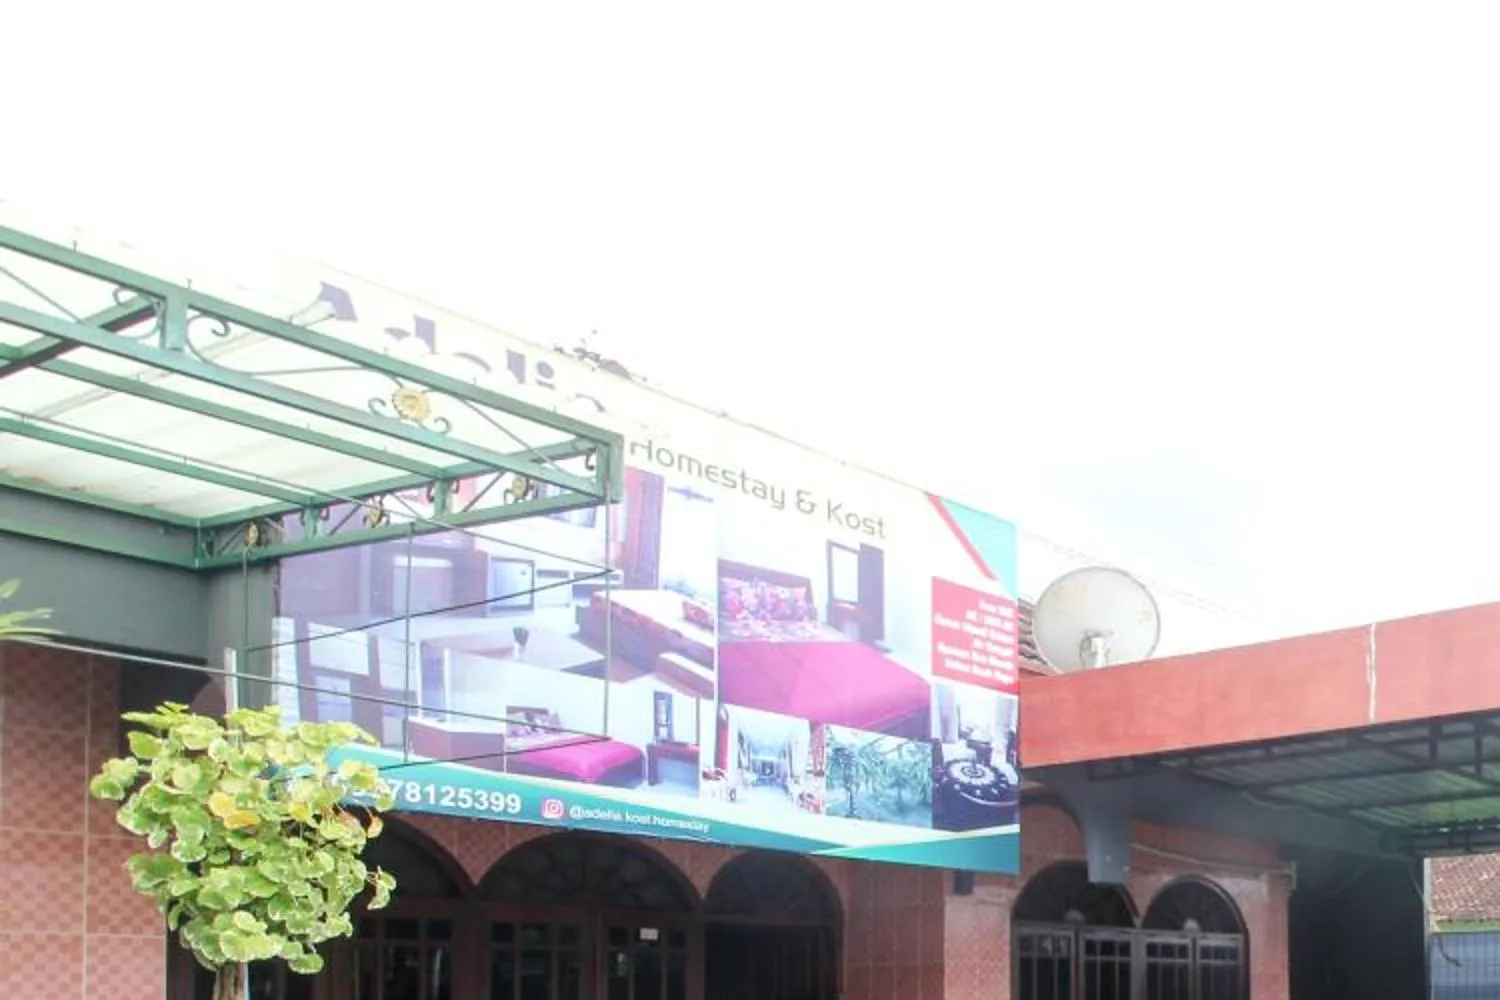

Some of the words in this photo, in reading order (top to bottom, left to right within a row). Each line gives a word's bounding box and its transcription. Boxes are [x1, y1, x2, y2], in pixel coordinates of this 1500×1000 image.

[629, 439, 786, 511] Homestay
[795, 489, 817, 515] &
[826, 498, 886, 539] Kost
[331, 771, 522, 813] 78125399
